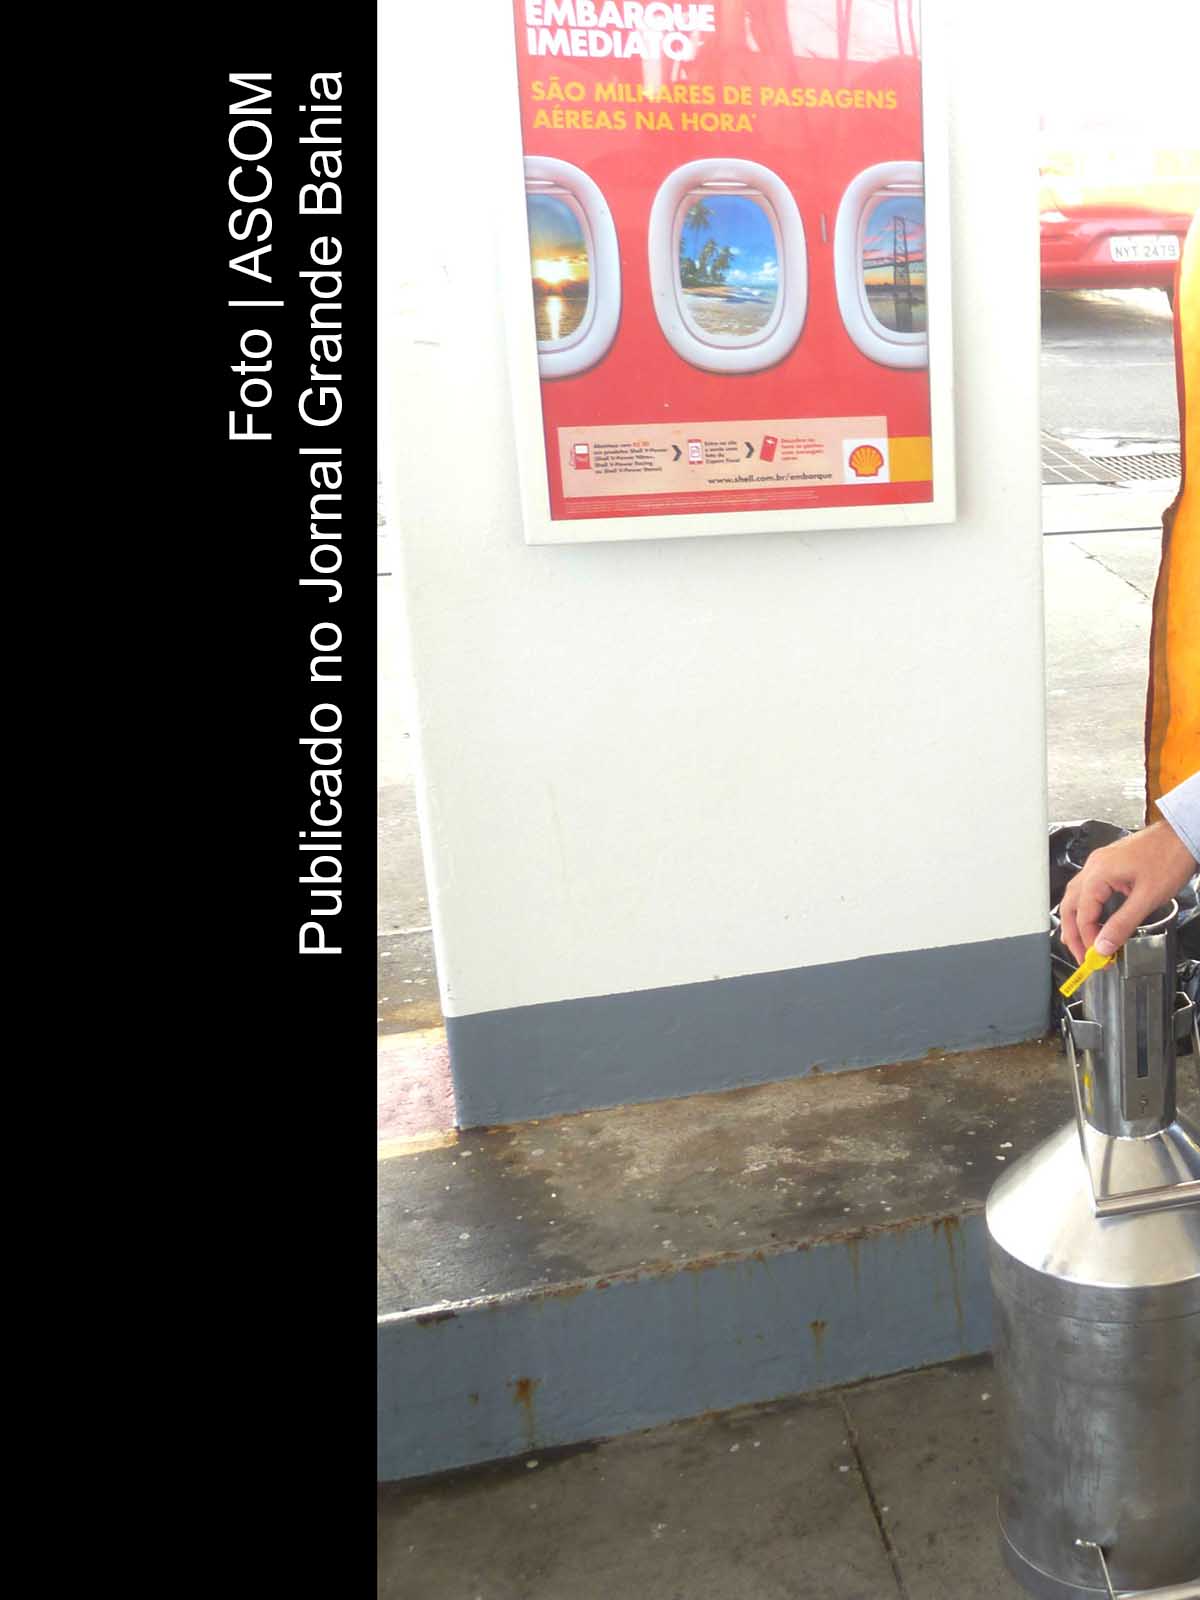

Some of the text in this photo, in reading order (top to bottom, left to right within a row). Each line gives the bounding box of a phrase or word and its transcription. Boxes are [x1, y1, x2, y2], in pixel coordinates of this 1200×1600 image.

[526, 2, 715, 33] EMBARQUE
[527, 28, 691, 60] IMEDIATO
[531, 77, 897, 109] SÃO MILHARES DE PASSAGENS
[533, 103, 626, 130] AÉREAS
[635, 111, 673, 131] NA
[708, 472, 832, 485] www.shell.com.br/embarque
